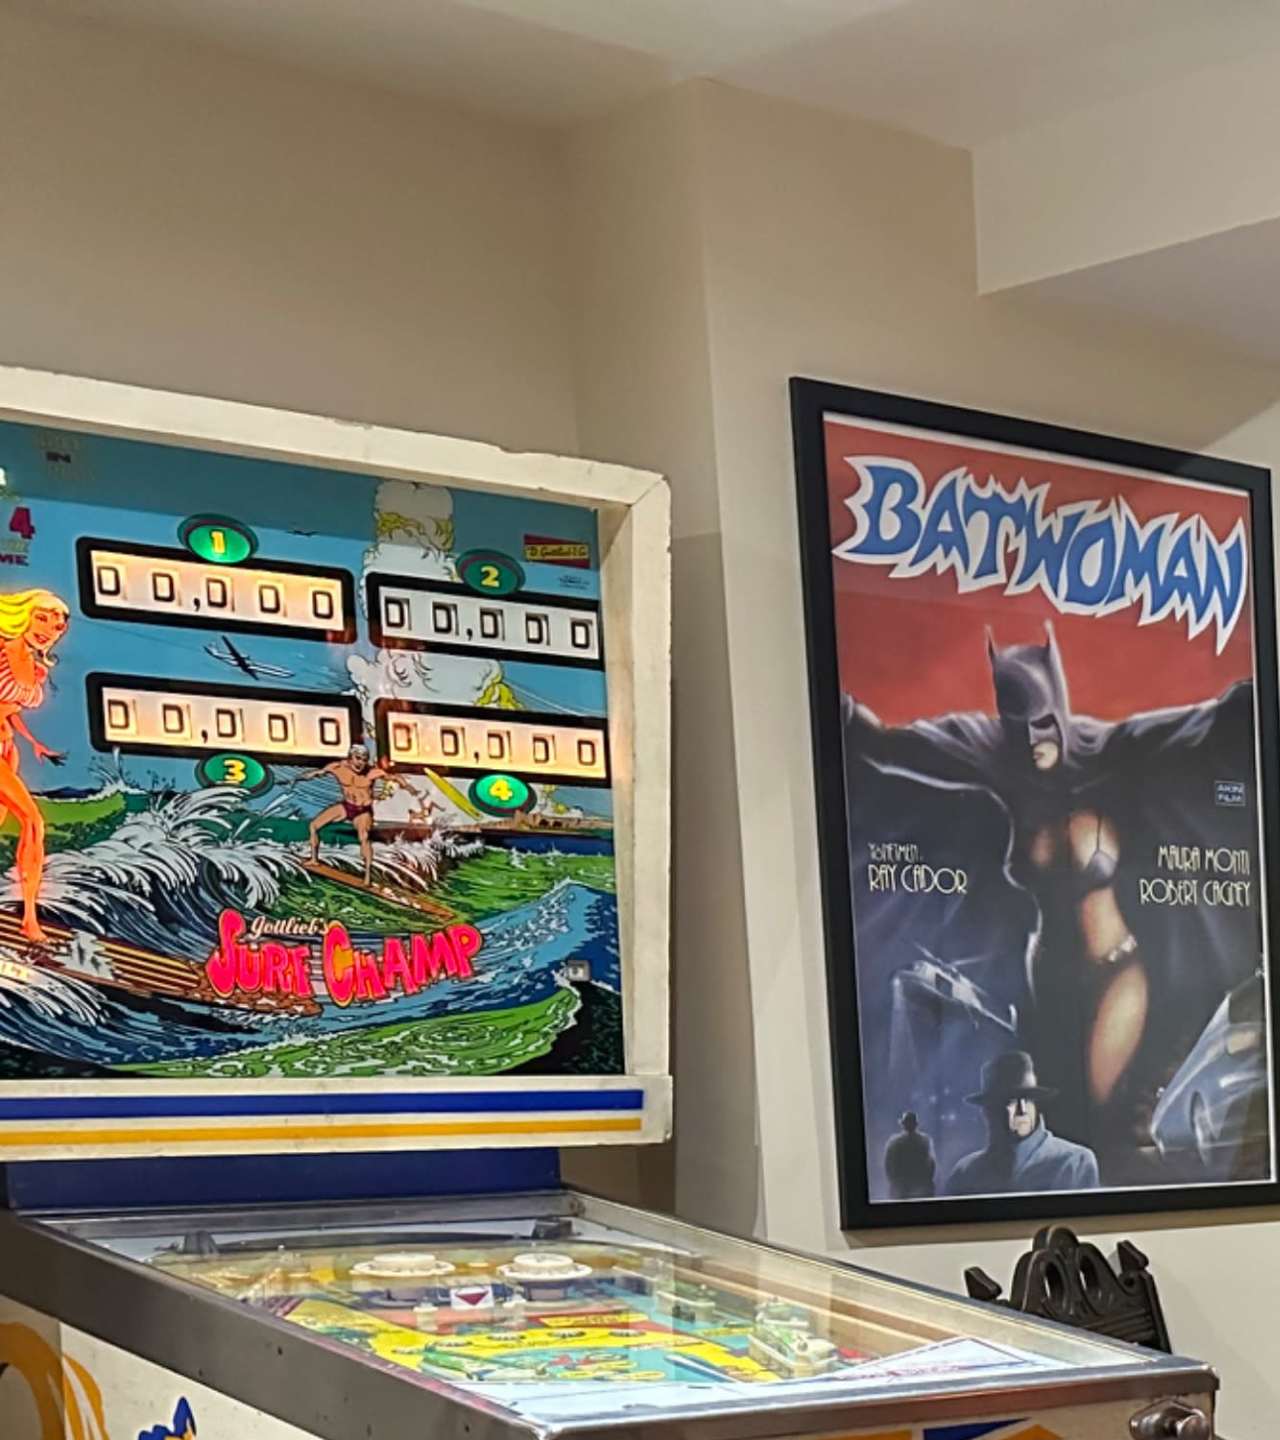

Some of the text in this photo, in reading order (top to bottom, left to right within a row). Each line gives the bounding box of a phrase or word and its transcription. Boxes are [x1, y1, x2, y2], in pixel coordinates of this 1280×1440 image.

[832, 456, 1246, 655] BATWOMAN
[868, 863, 968, 896] RAY CADOR
[1139, 878, 1198, 906] ROBERT
